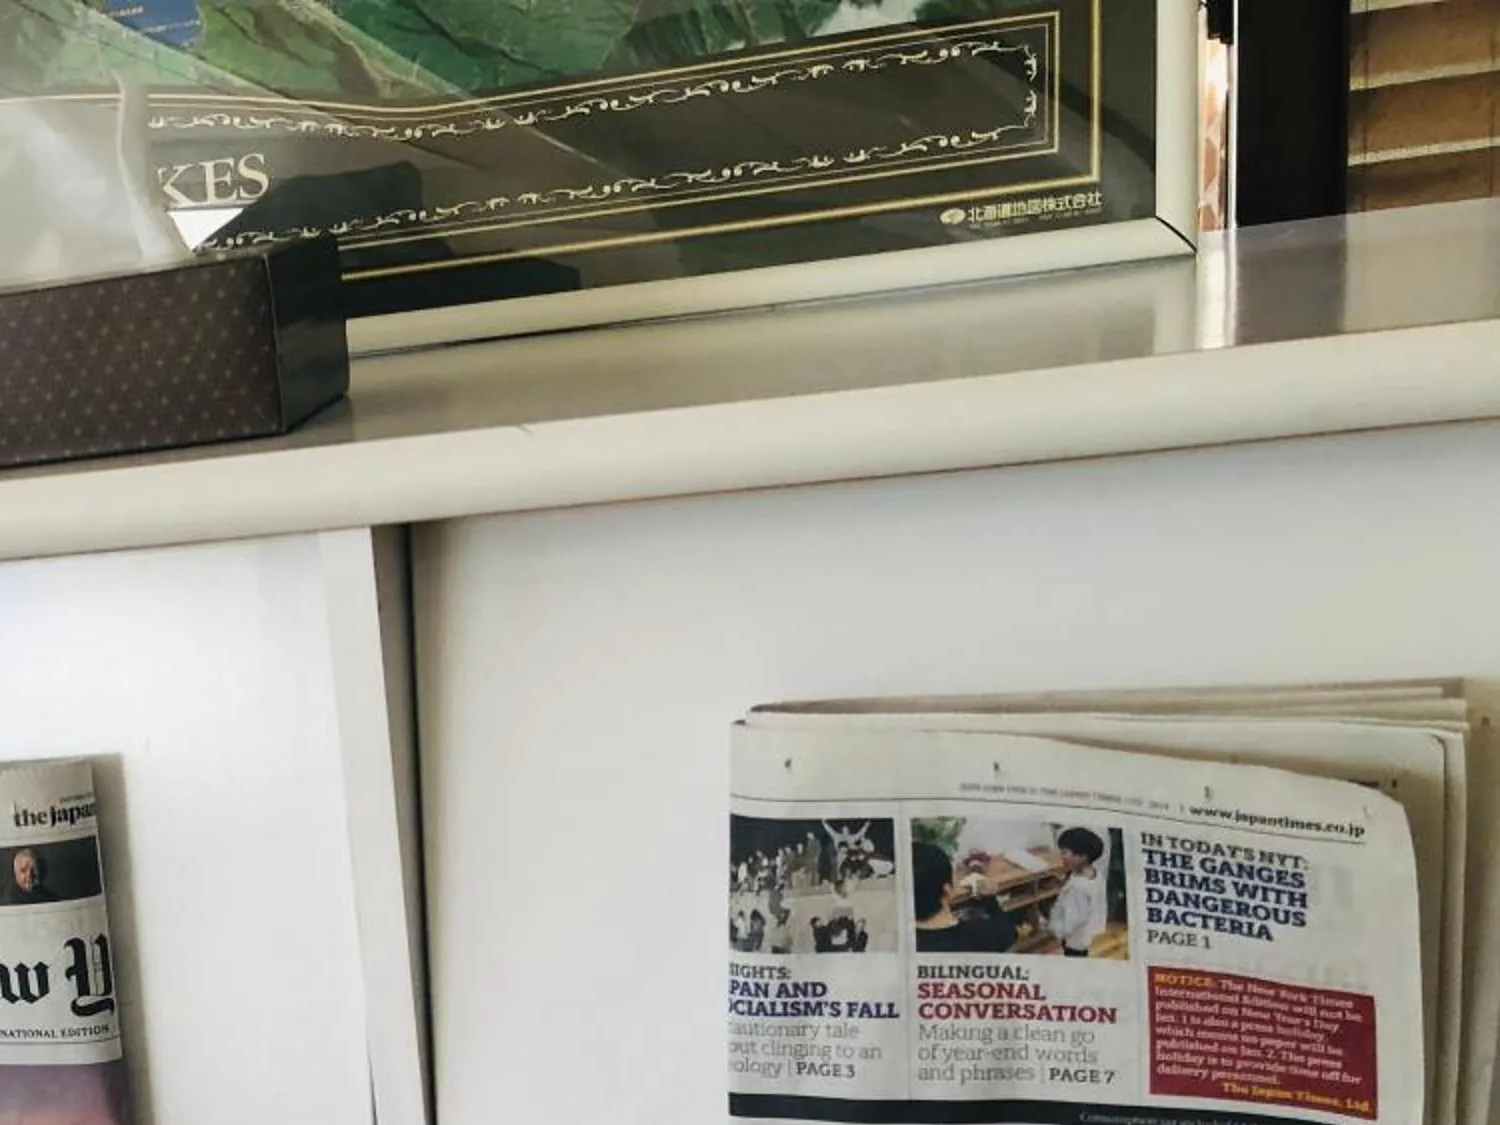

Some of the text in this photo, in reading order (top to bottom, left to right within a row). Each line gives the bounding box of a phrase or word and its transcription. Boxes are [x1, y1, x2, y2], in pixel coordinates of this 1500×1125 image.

[1189, 803, 1366, 838] www.japantimes.co.jp
[1140, 832, 1164, 848] IN
[1166, 836, 1256, 863] TODAY'S
[1142, 848, 1306, 889] THE GANGES
[1144, 867, 1309, 909] BRIMS WITH
[1145, 887, 1307, 928] DANGEROUS
[1146, 906, 1274, 942] BACTERIA
[1147, 929, 1198, 947] PAGE
[916, 964, 1030, 981] BILINGUAL:
[775, 981, 828, 998] AND
[917, 982, 1047, 1001] SEASONAL
[728, 999, 901, 1019] CIALISM'S FALL
[918, 1002, 1117, 1024] CONVERSATION
[59, 1023, 110, 1039] EDITION
[729, 1022, 861, 1041] autionary tale
[918, 1024, 1096, 1048] Making a clean go
[761, 1040, 833, 1063] clinging
[836, 1044, 855, 1060] to
[858, 1047, 883, 1060] an
[918, 1043, 1098, 1066] of year-end words
[796, 1061, 842, 1077] PAGE
[918, 1064, 1115, 1085] and phrases PAGE 7
